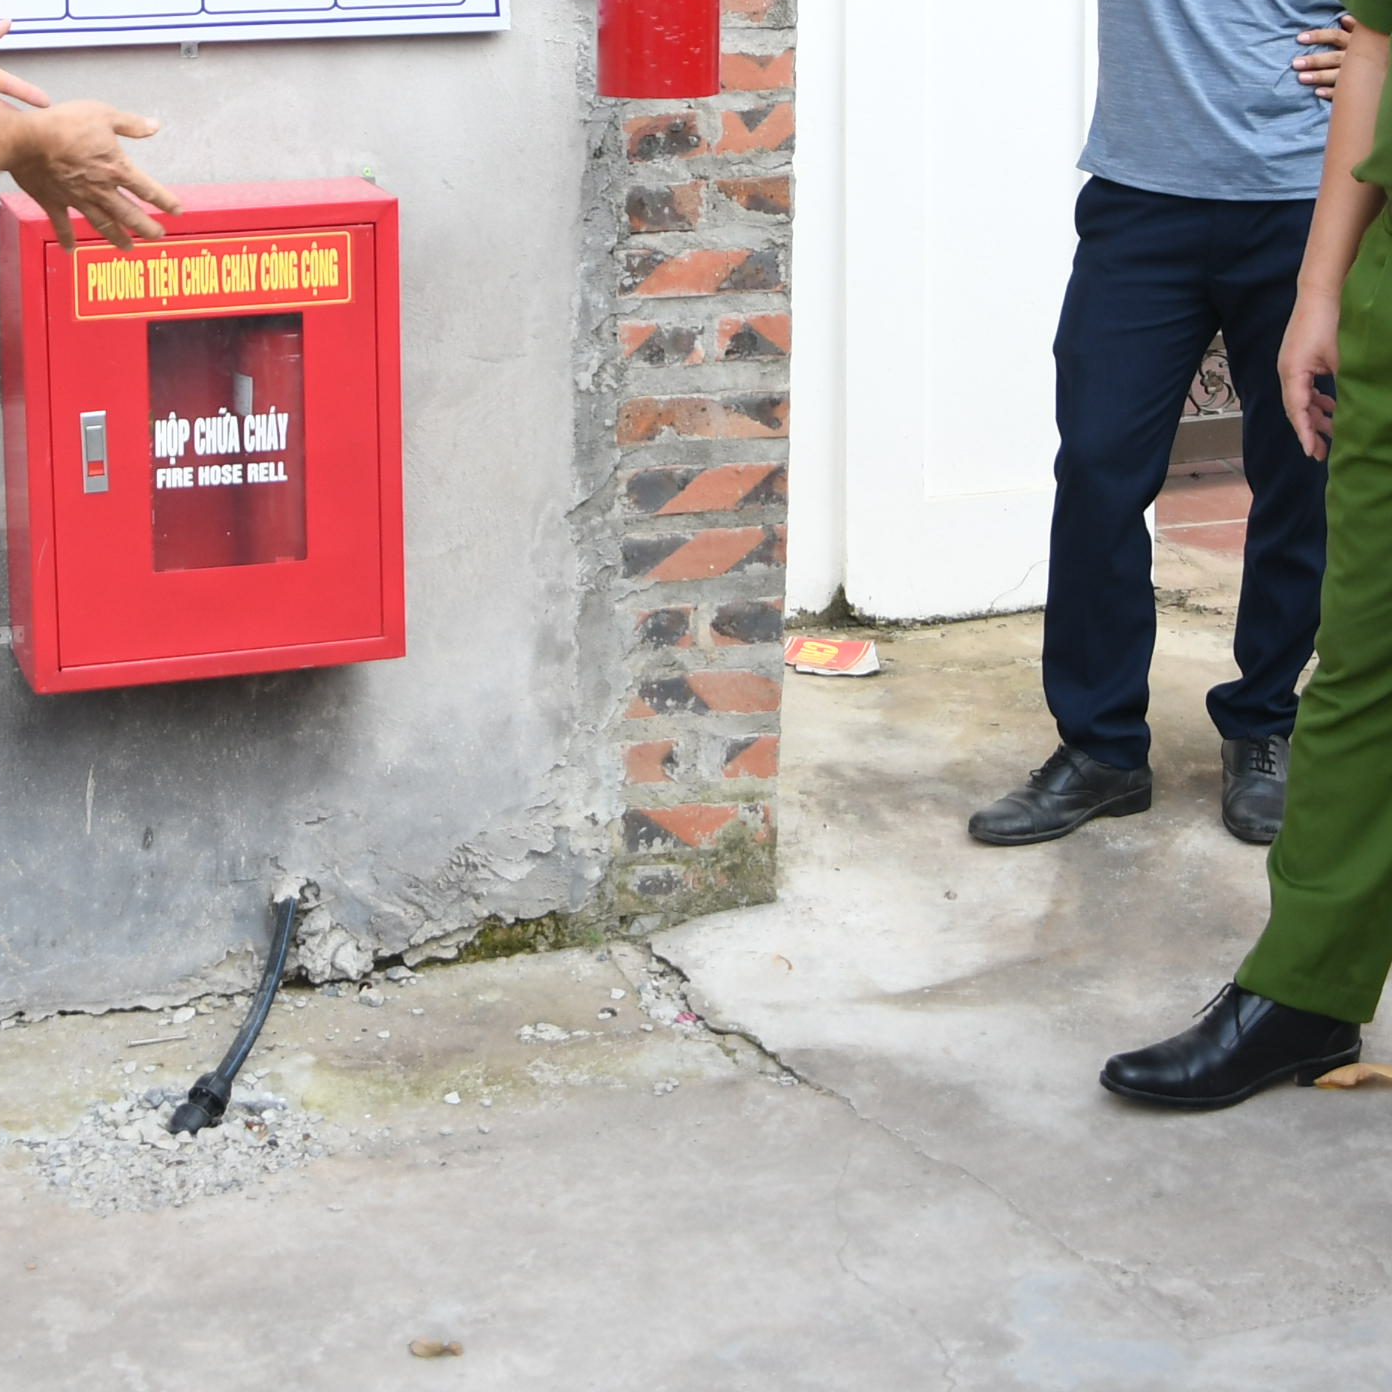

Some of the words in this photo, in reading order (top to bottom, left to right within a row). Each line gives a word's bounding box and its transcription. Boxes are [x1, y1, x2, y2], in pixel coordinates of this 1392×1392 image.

[87, 257, 145, 302] PHƯƠNG
[147, 249, 179, 306] TIỆN
[181, 248, 219, 296] CHỮA
[222, 245, 258, 293] CHÁY
[260, 243, 298, 291] CÔNG
[301, 241, 339, 296] CỘNG
[155, 411, 190, 465] HỘP
[194, 407, 240, 455] CHỮA
[244, 405, 289, 452] CHÁY
[156, 466, 194, 489] FIRE
[198, 464, 243, 486] HOSE
[247, 461, 288, 483] RELL
